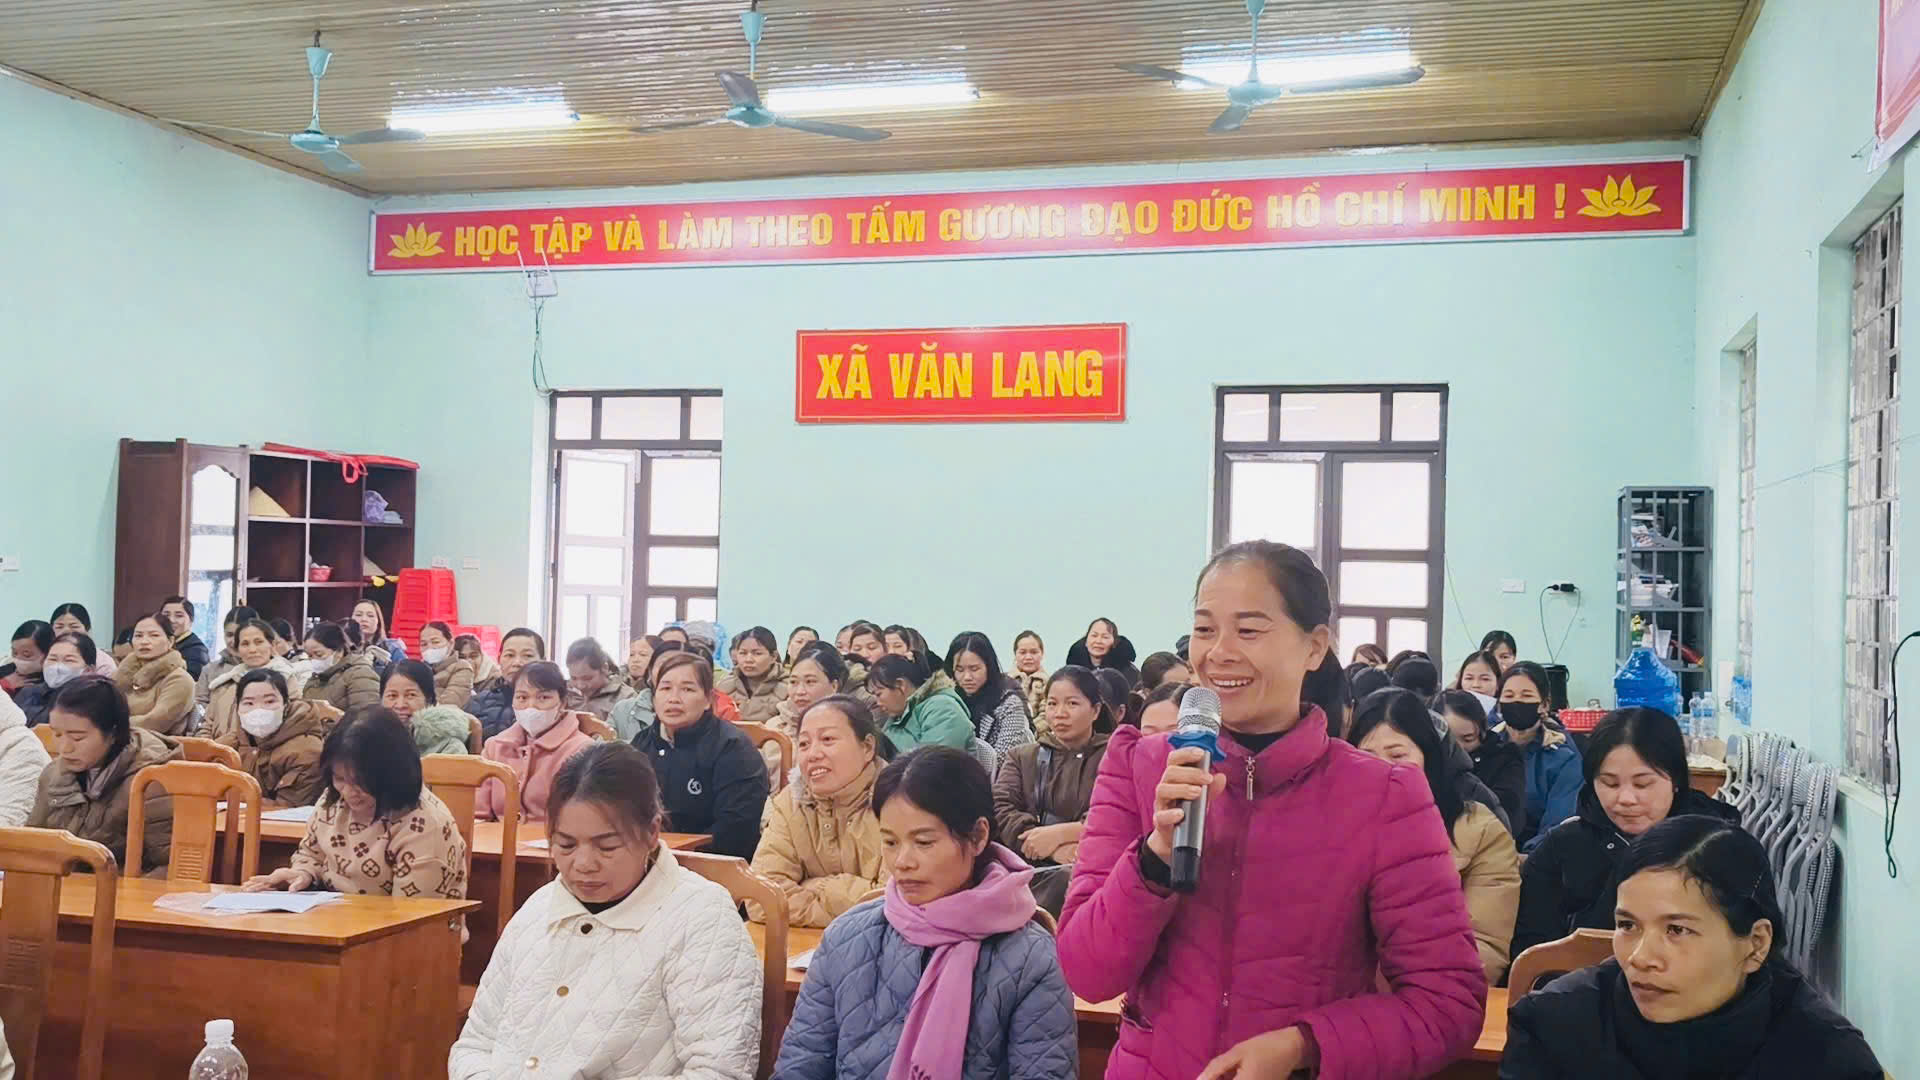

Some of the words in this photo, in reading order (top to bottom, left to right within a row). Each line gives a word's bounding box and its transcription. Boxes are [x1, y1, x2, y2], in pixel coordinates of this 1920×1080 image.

[455, 225, 519, 261] HỌC
[531, 216, 593, 259] TẬP
[603, 214, 645, 252] VÀ
[658, 212, 732, 251] LÀM
[746, 213, 834, 249] THEO
[847, 201, 926, 245] TẤM
[939, 202, 1066, 242] GƯƠNG
[1081, 200, 1160, 243] ĐẠO
[1171, 188, 1253, 233] ĐỨC
[1267, 182, 1320, 229] HỒ
[1335, 182, 1408, 227] CHÍ
[1419, 184, 1535, 224] MINH
[1555, 183, 1567, 219] !
[816, 344, 873, 399] XÃ
[888, 341, 973, 399] VĂN
[992, 350, 1104, 398] LANG
